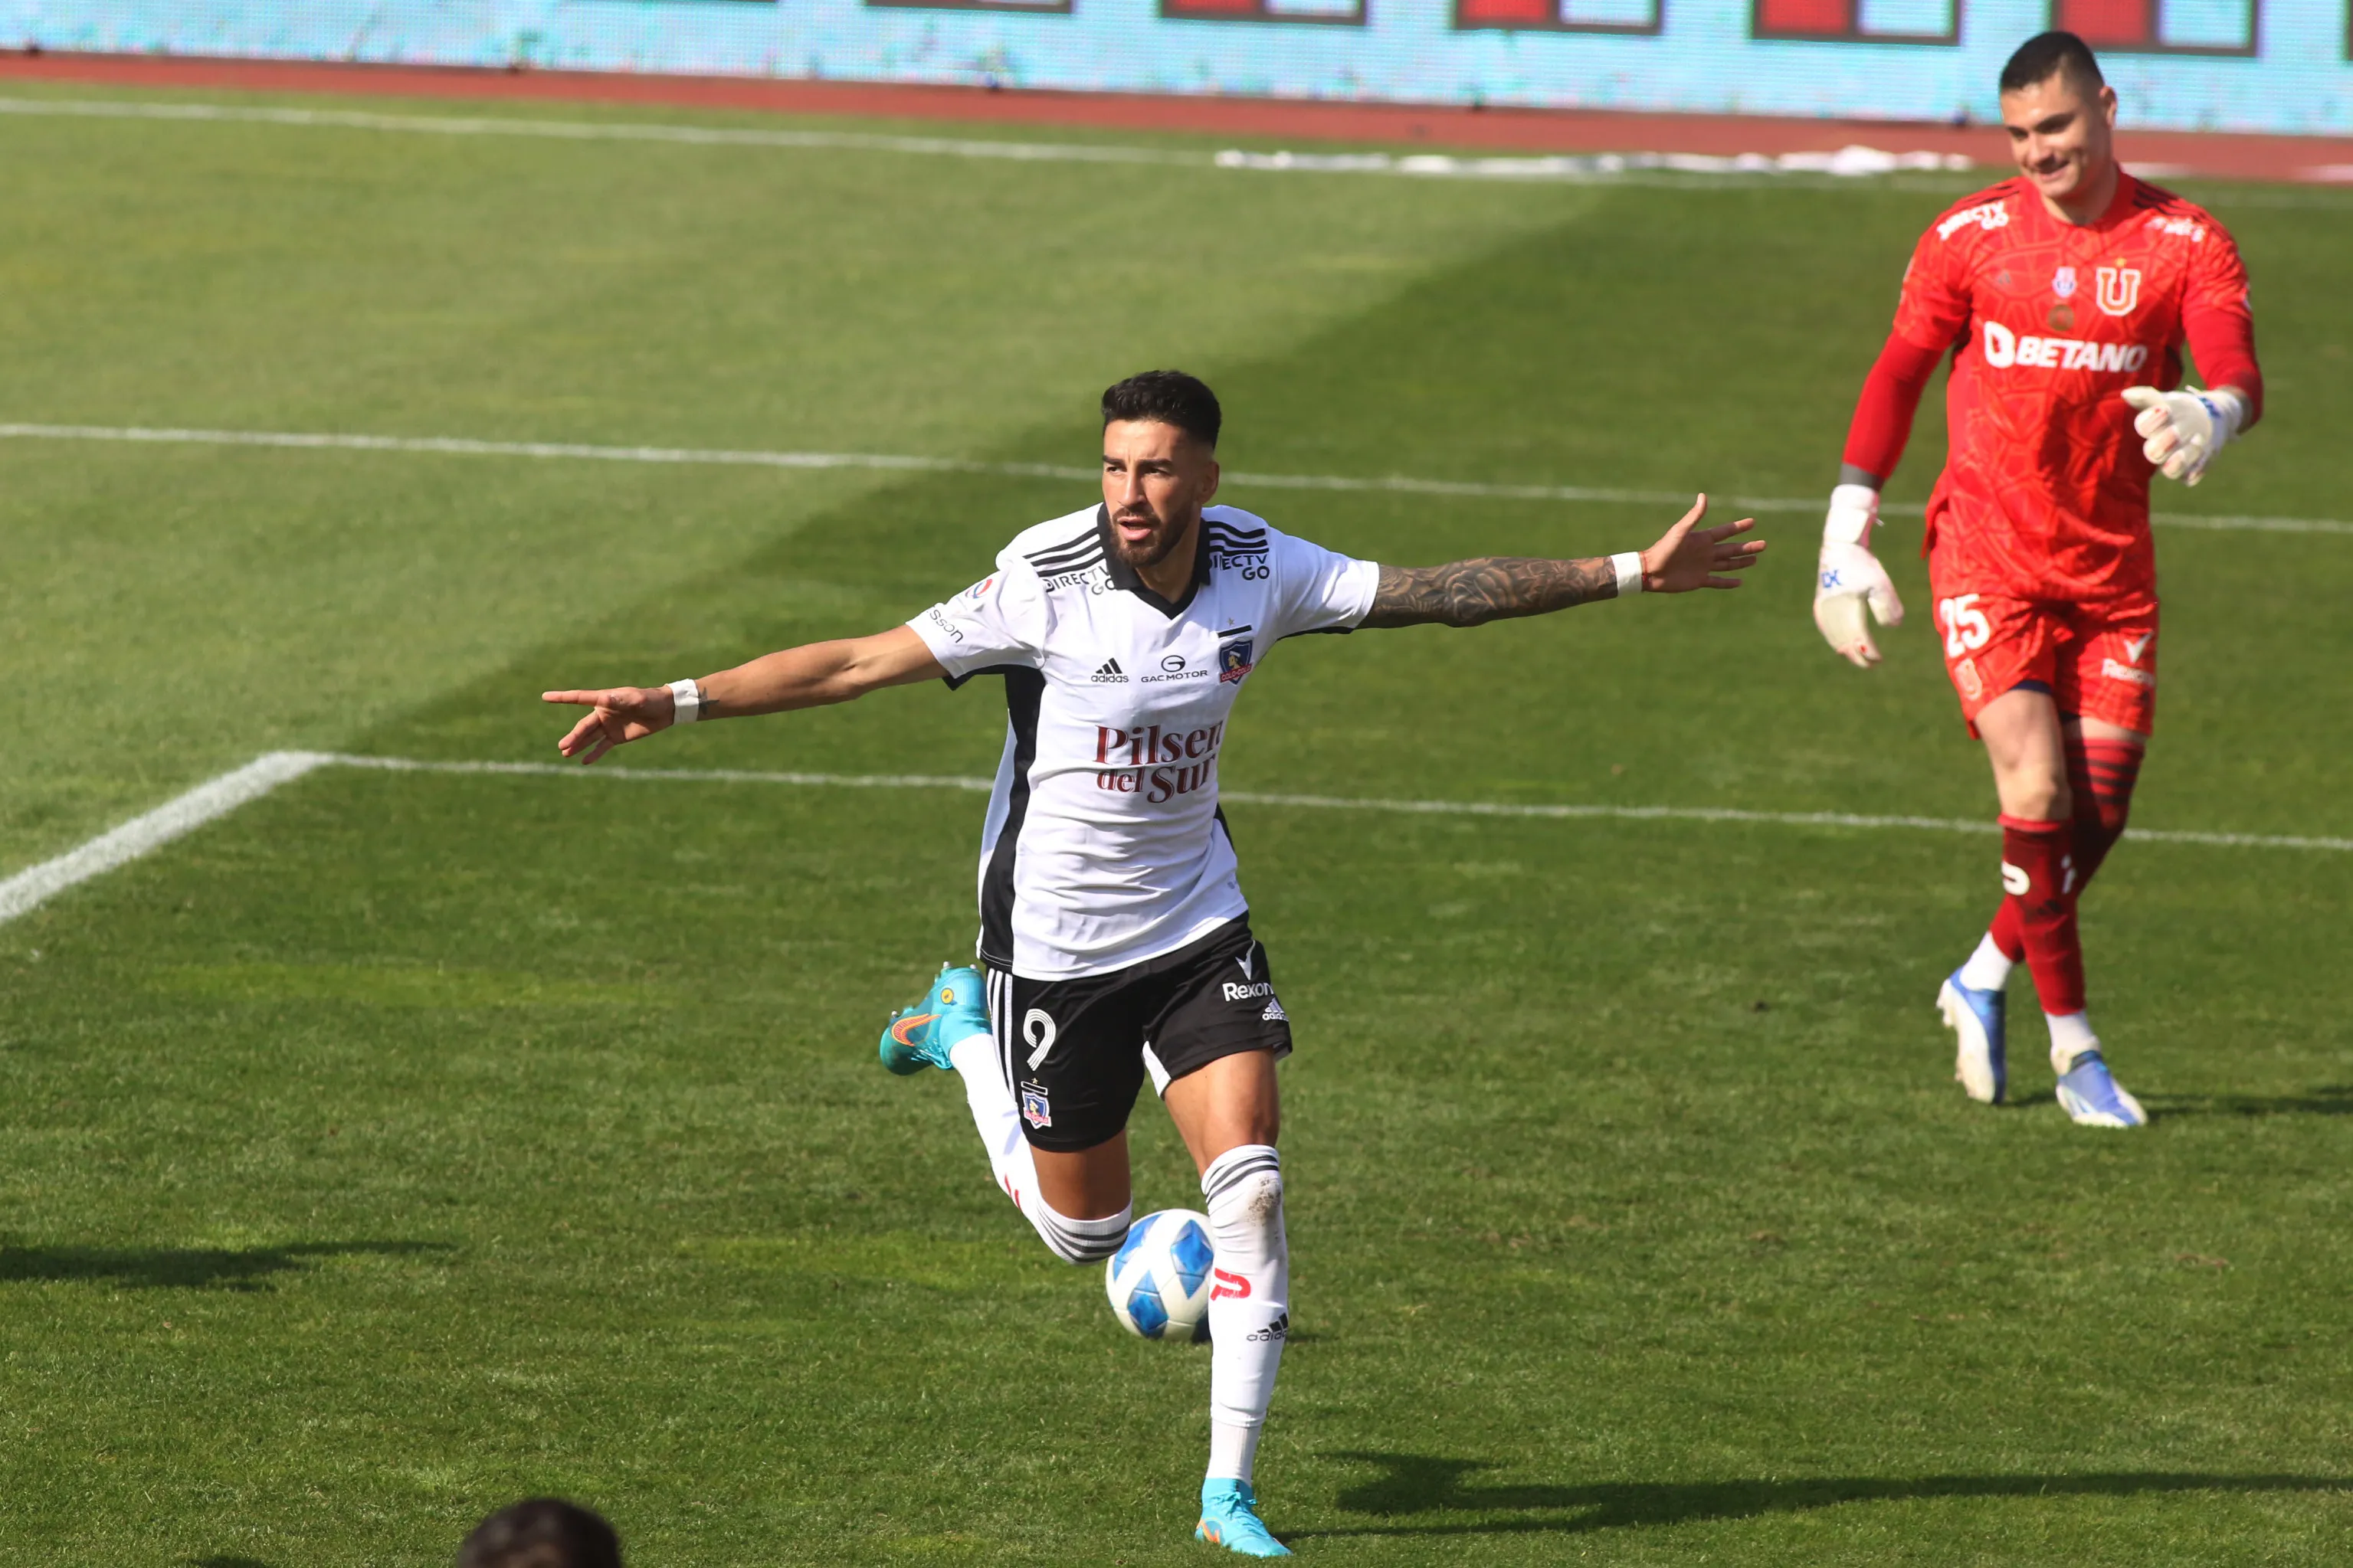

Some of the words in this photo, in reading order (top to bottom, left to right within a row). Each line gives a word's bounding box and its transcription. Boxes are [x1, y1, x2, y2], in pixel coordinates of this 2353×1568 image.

[2015, 336, 2148, 373] BETANO
[1091, 578, 1115, 595] GO
[1242, 565, 1270, 581] GO
[927, 608, 964, 644] sson
[1091, 673, 1129, 683] adidas
[1141, 675, 1165, 683] GAC
[1166, 669, 1208, 681] MOTOR
[1093, 720, 1224, 766] Pilsen
[1097, 766, 1146, 793] del
[1147, 754, 1216, 804] Sur
[1222, 982, 1274, 1002] Rexon
[1023, 1008, 1057, 1072] 9
